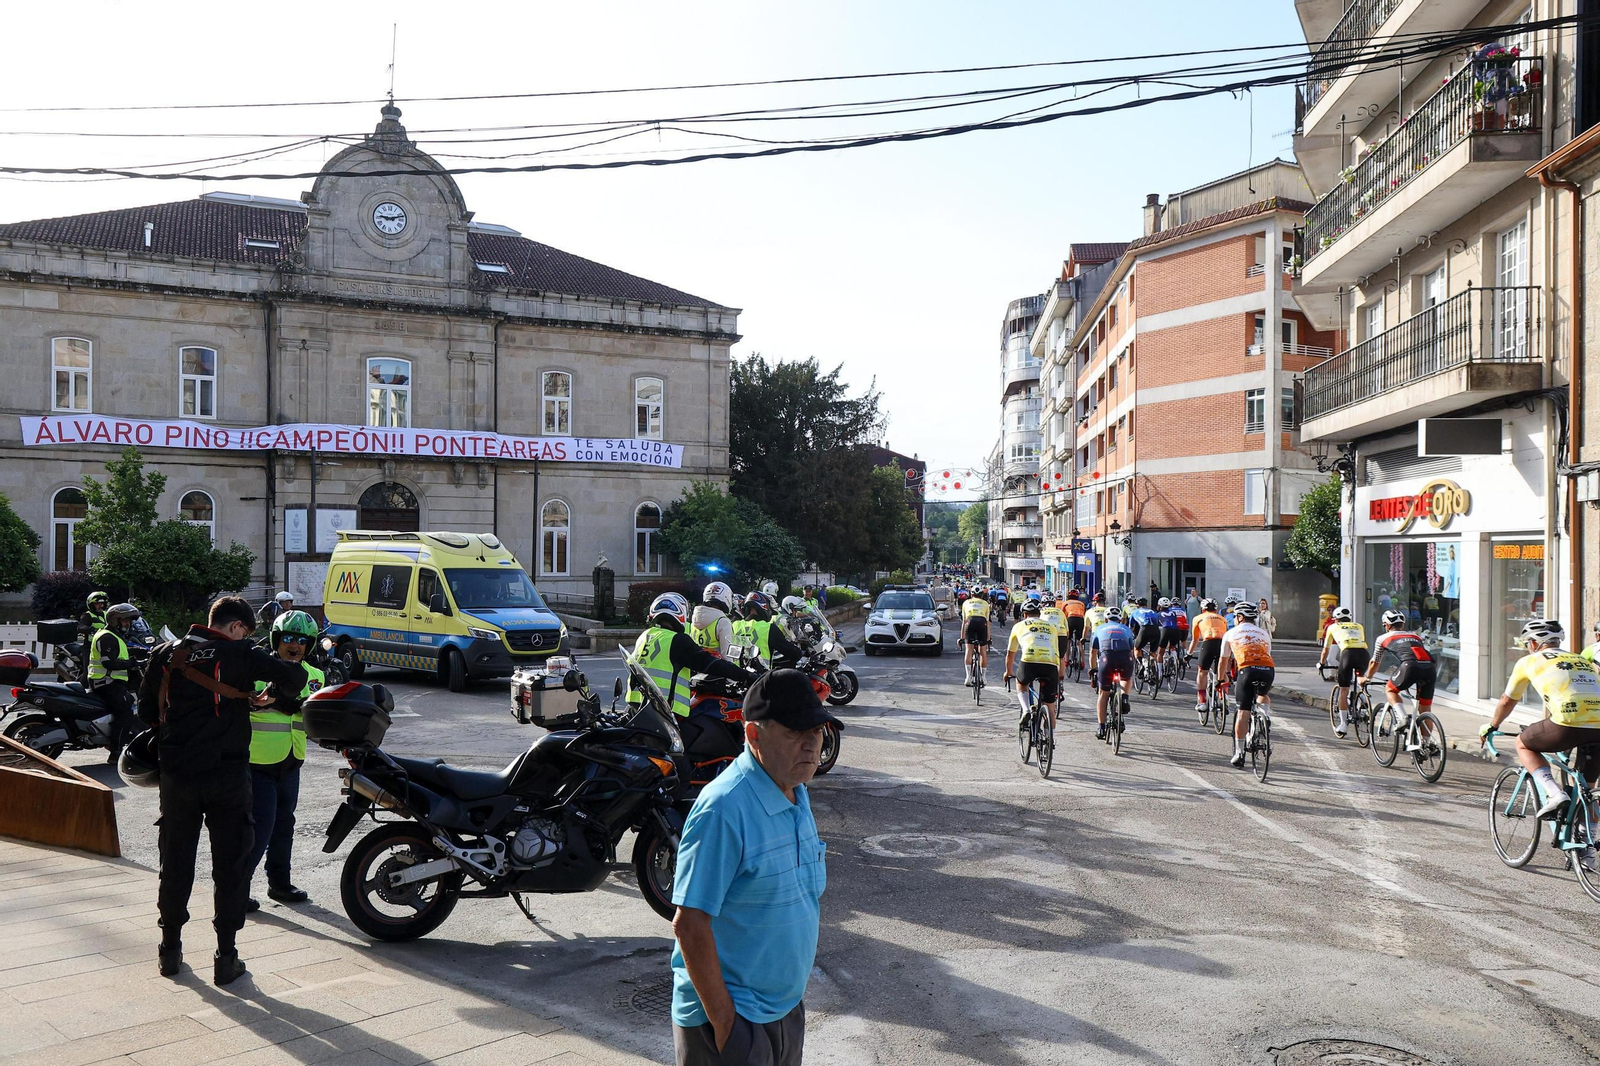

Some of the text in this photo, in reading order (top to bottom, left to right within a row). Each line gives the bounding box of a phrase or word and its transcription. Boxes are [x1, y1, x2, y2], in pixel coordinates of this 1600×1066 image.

[338, 282, 440, 299] CASA CONSISTORIAL
[35, 415, 152, 445] ÁLVARO
[165, 425, 230, 448] PINO
[415, 434, 567, 460] PONTEAREAS
[574, 438, 673, 454] TE SALUDA
[575, 450, 673, 466] CON EMOCIÓN
[1432, 488, 1470, 516] ORO
[1493, 545, 1521, 559] CENTRO
[369, 630, 405, 642] AMBULANCIA
[698, 633, 704, 645] 6
[640, 643, 651, 657] 5
